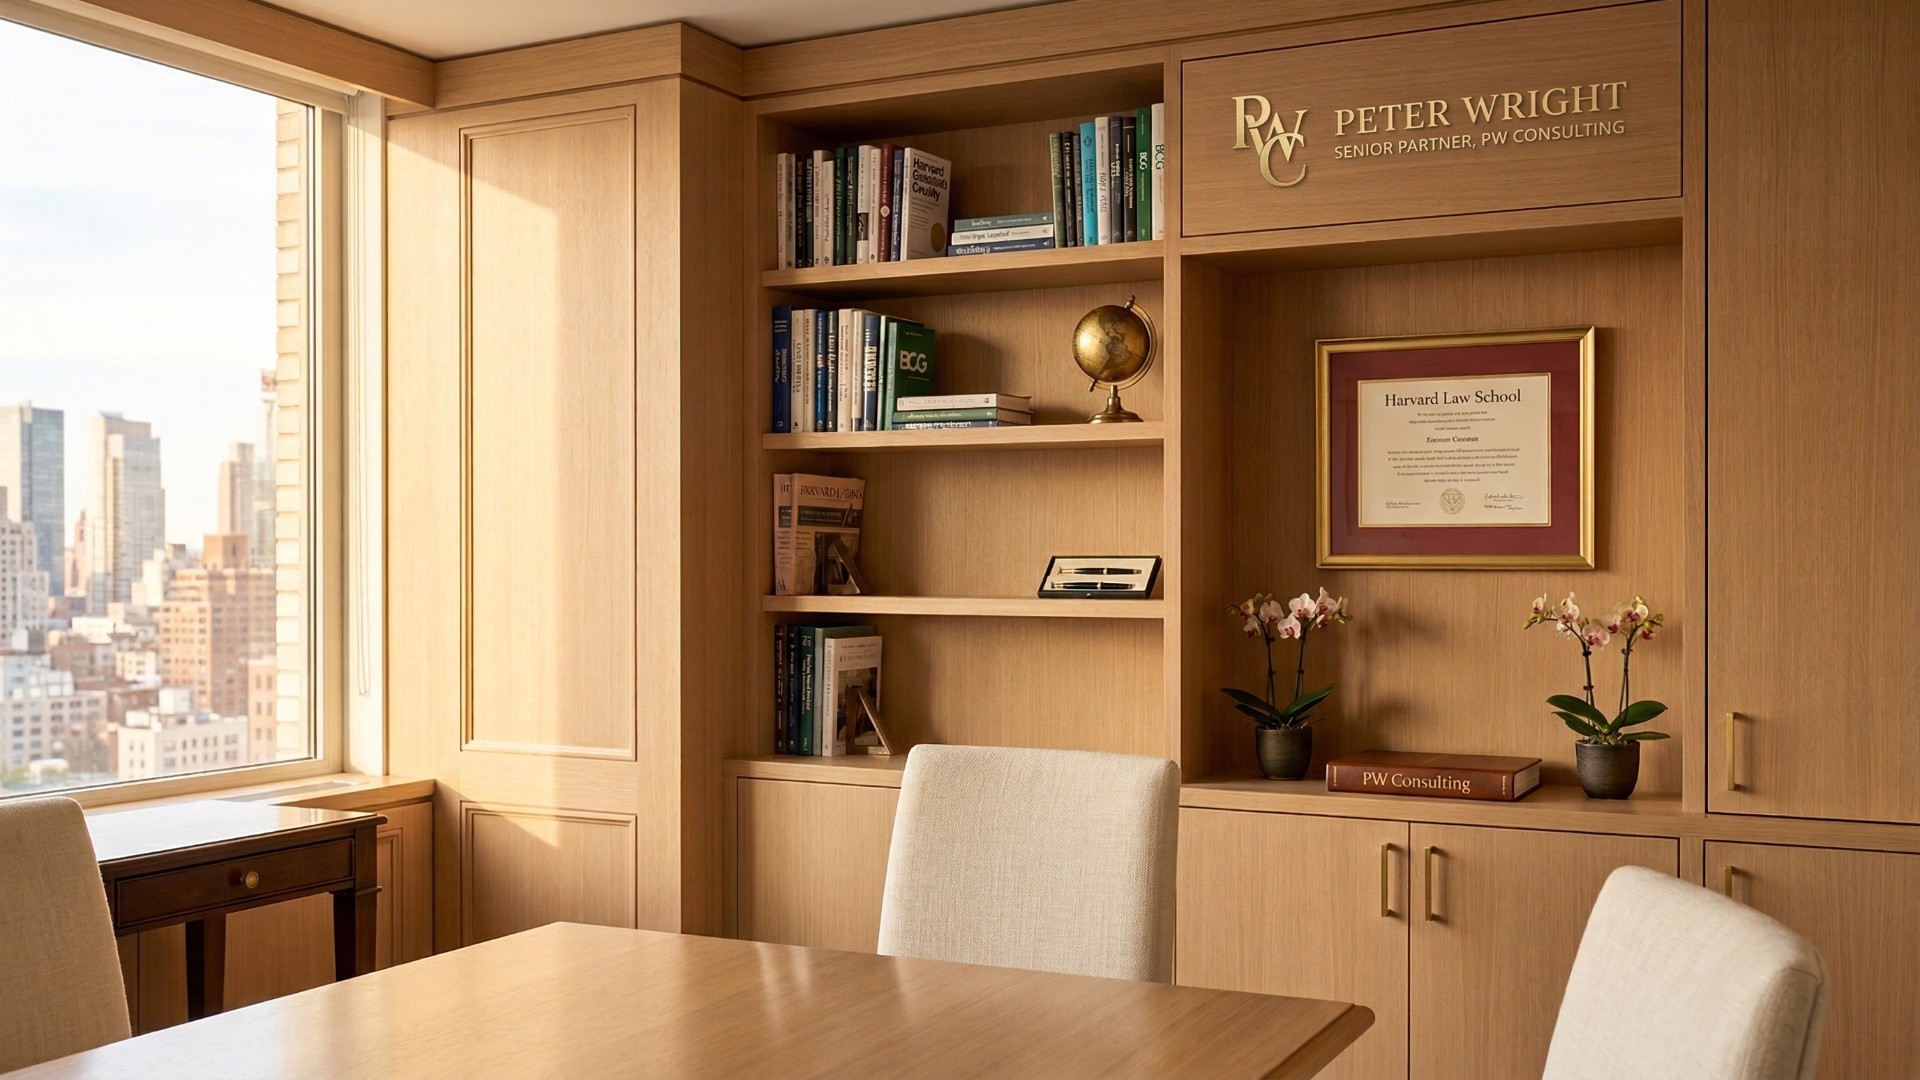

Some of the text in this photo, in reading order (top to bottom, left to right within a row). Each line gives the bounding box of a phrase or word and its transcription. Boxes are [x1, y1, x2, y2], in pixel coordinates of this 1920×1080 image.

[1334, 81, 1627, 136] PETER WRIGHT
[1334, 120, 1625, 160] SENIOR PARTNER, PW CONSULTING
[899, 349, 928, 374] BCG
[1385, 389, 1522, 407] Harvard Law School
[1363, 772, 1471, 795] PW Consulting
